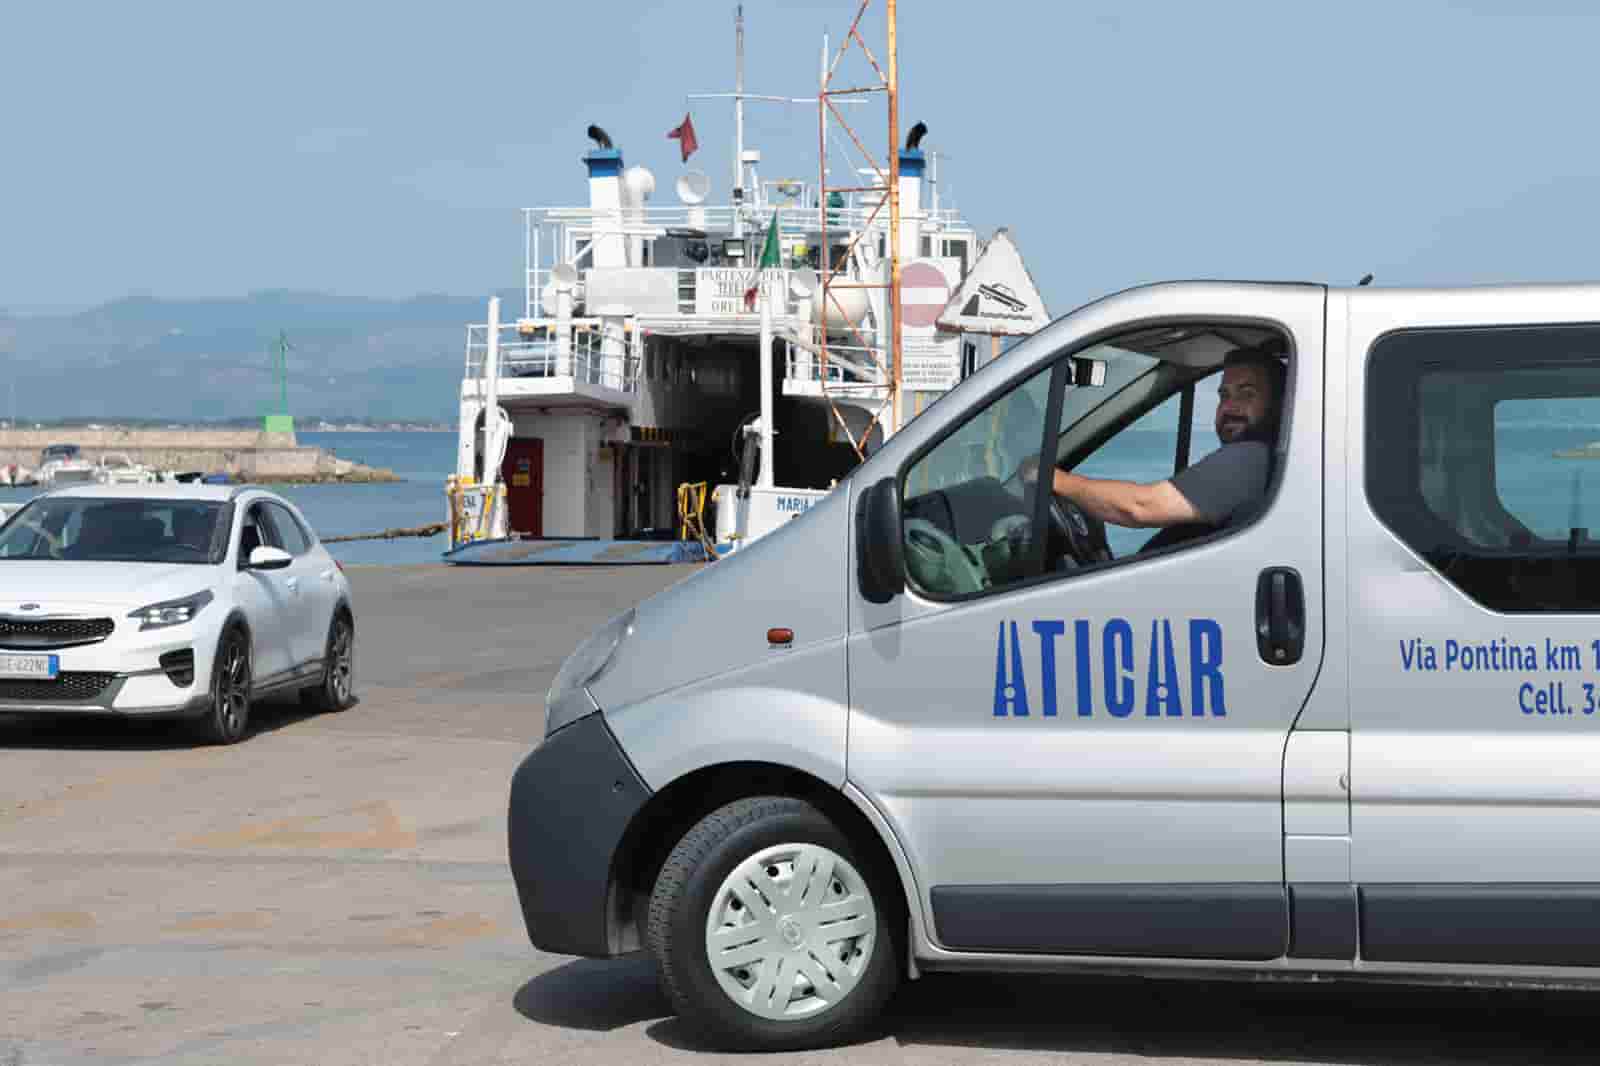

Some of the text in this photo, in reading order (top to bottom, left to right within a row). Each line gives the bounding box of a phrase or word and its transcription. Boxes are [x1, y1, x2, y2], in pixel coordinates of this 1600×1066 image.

[701, 269, 760, 281] PARTENZ
[993, 617, 1227, 718] ATICAR
[1399, 637, 1437, 671] Via
[1445, 637, 1537, 671] Pontina
[1545, 637, 1581, 671] km
[1518, 681, 1573, 715] Cell.
